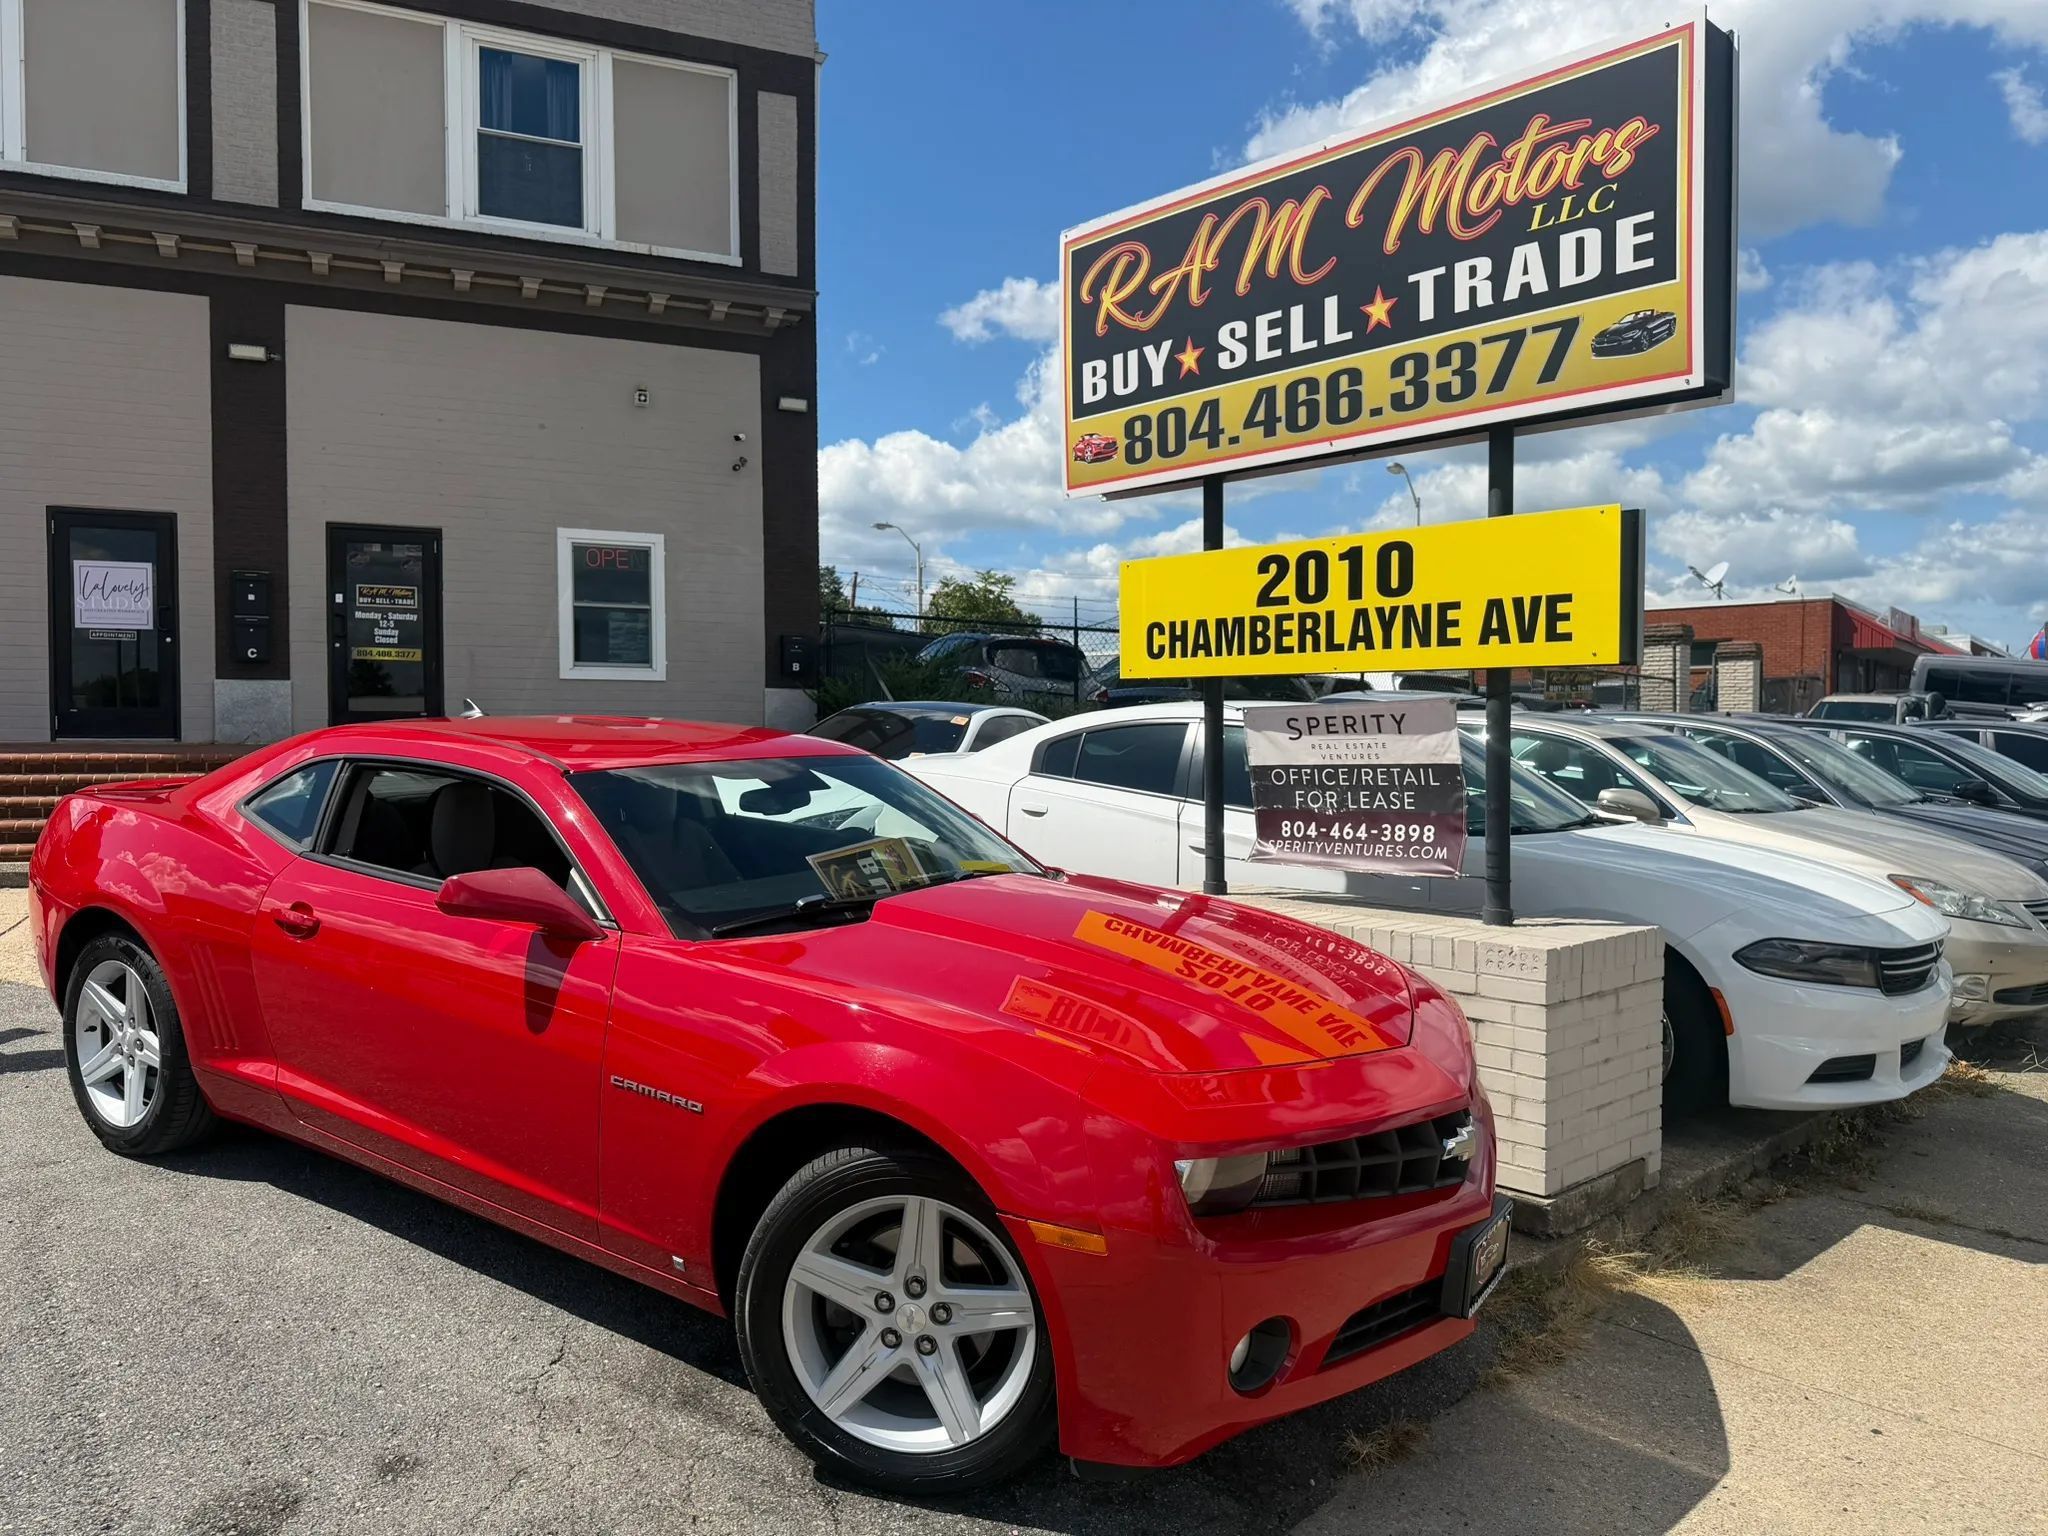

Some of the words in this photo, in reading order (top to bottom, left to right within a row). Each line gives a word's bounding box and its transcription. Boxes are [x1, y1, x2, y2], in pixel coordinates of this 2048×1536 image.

[1345, 113, 1660, 255] Motors
[1526, 183, 1618, 232] LLC
[1082, 338, 1175, 405] BUY
[1217, 294, 1353, 370] SELL
[1408, 210, 1655, 322] TRADE
[1123, 315, 1585, 467] 804.466.3377
[1255, 540, 1415, 608] 2010
[355, 611, 382, 620] Monday
[388, 612, 418, 622] Saturday
[1146, 601, 1462, 660] CHAMBERLAYNE
[1479, 592, 1573, 646] AVE
[374, 628, 399, 637] Sunday
[375, 636, 398, 644] Closed
[1286, 713, 1407, 740] SPERITY
[1346, 742, 1387, 750] ESTATE
[1271, 768, 1440, 786] OFFICE/RETAIL
[1295, 791, 1338, 808] FOR
[1348, 792, 1416, 810] LEASE
[1281, 821, 1435, 843] 804-464-3898
[1268, 840, 1448, 860] SPERITYVENTURES.COM
[610, 1074, 703, 1113] CAMARO
